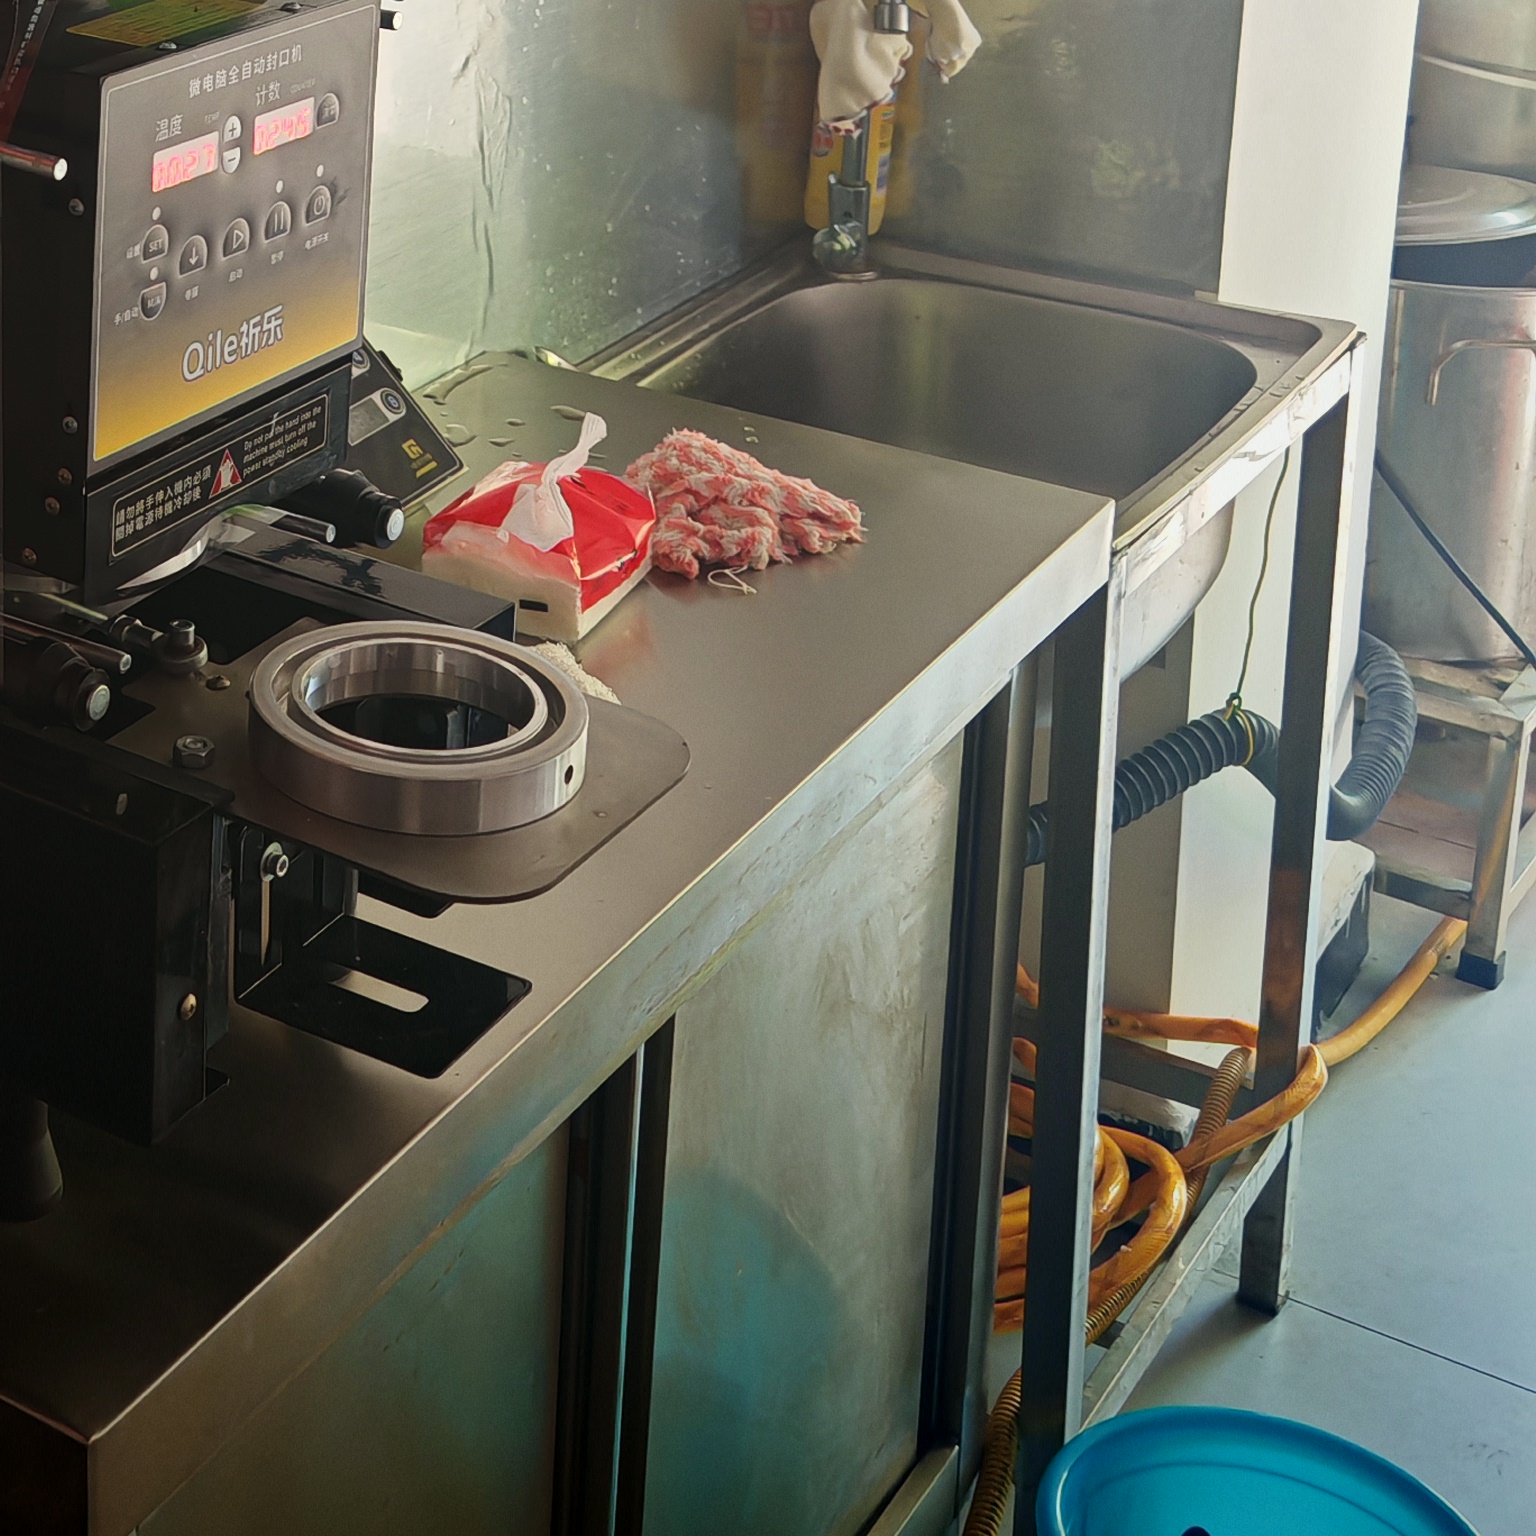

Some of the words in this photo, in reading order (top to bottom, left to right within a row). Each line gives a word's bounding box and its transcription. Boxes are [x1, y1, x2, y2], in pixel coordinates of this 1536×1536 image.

[189, 43, 302, 98] 微电脑全自动封口机
[255, 80, 282, 107] 计数
[155, 114, 183, 143] 温度
[148, 239, 163, 252] SET
[181, 305, 284, 382] Qile祈乐
[253, 433, 263, 446] not
[269, 436, 283, 450] must
[284, 431, 296, 442] turn
[287, 436, 308, 453] cooling
